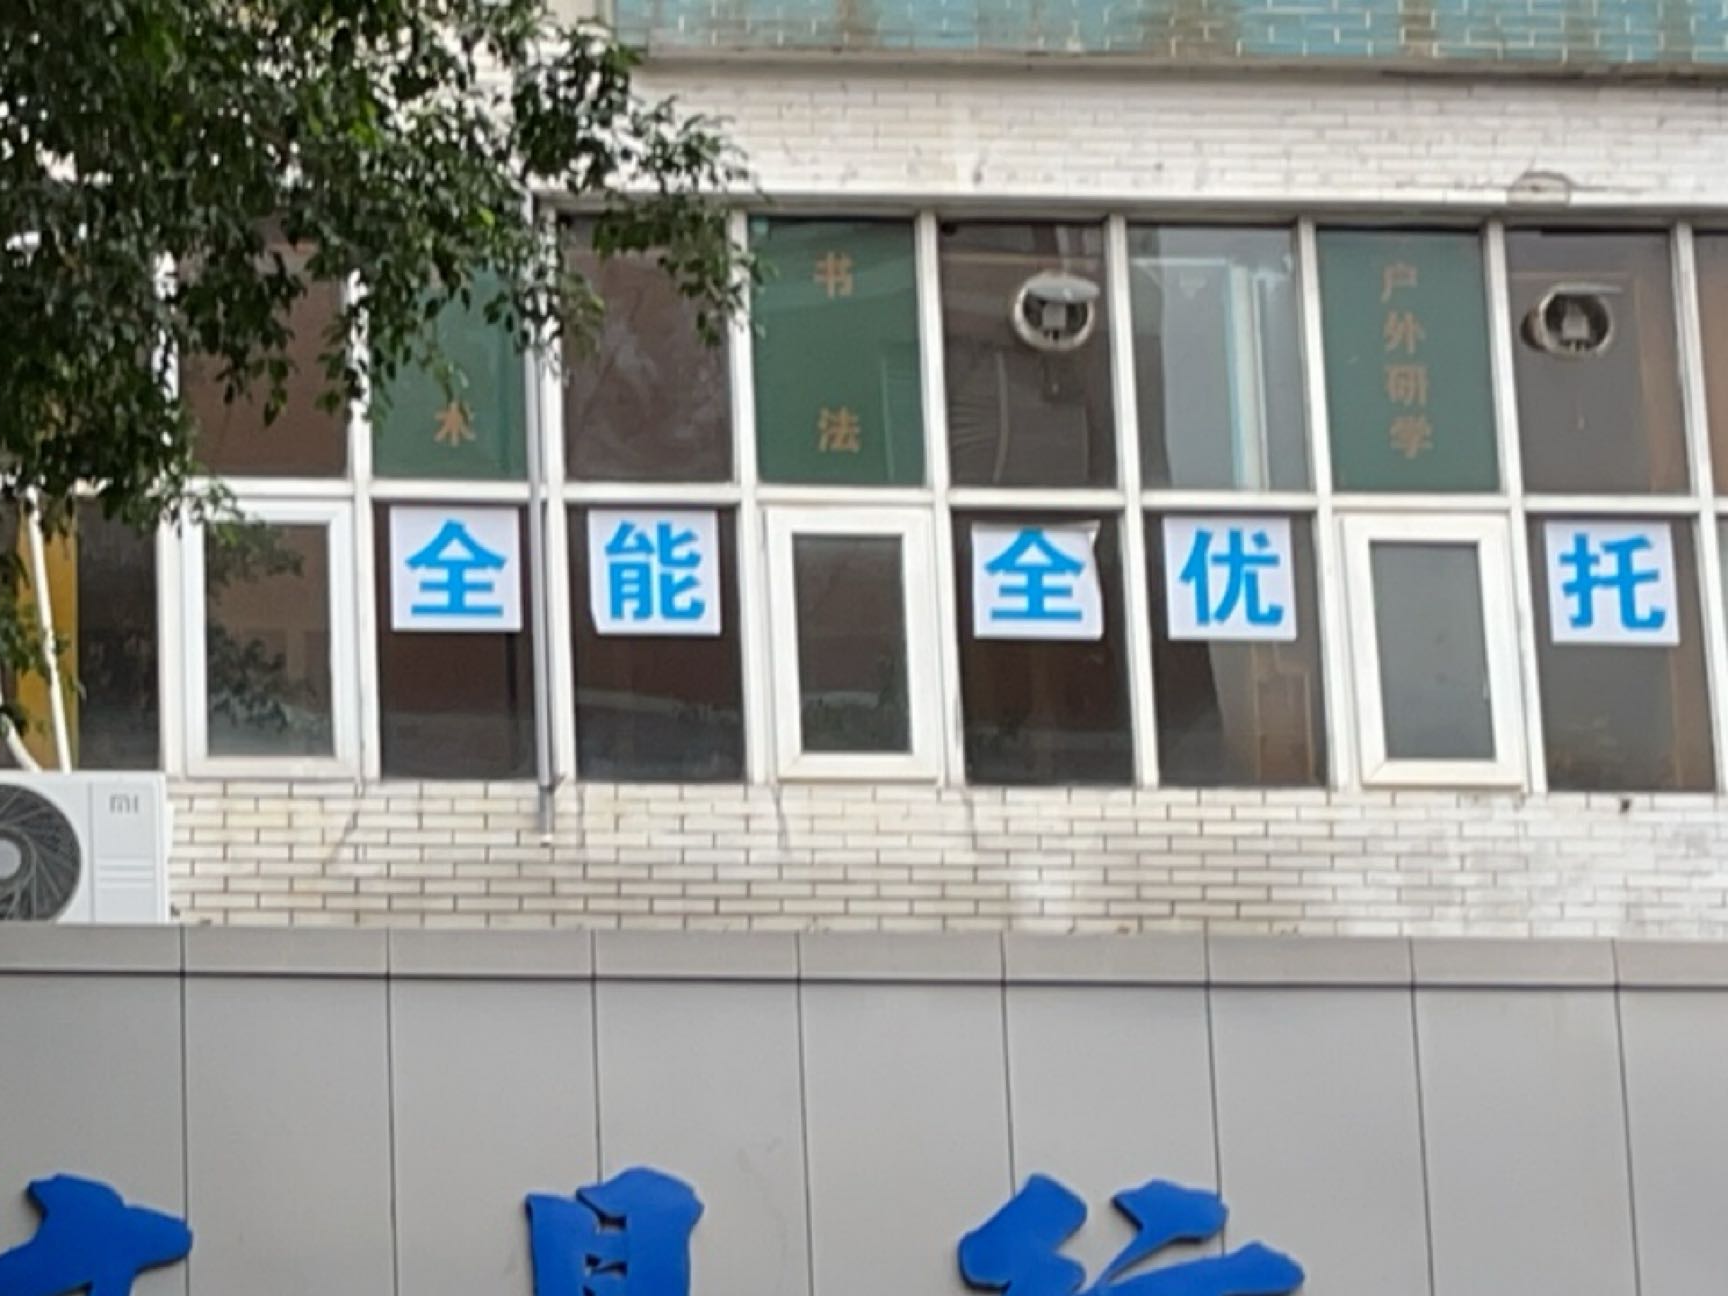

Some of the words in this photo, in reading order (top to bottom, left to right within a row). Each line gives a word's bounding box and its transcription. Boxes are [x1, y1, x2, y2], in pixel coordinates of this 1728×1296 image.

[813, 252, 863, 453] 书法
[1381, 261, 1434, 460] 户外研学
